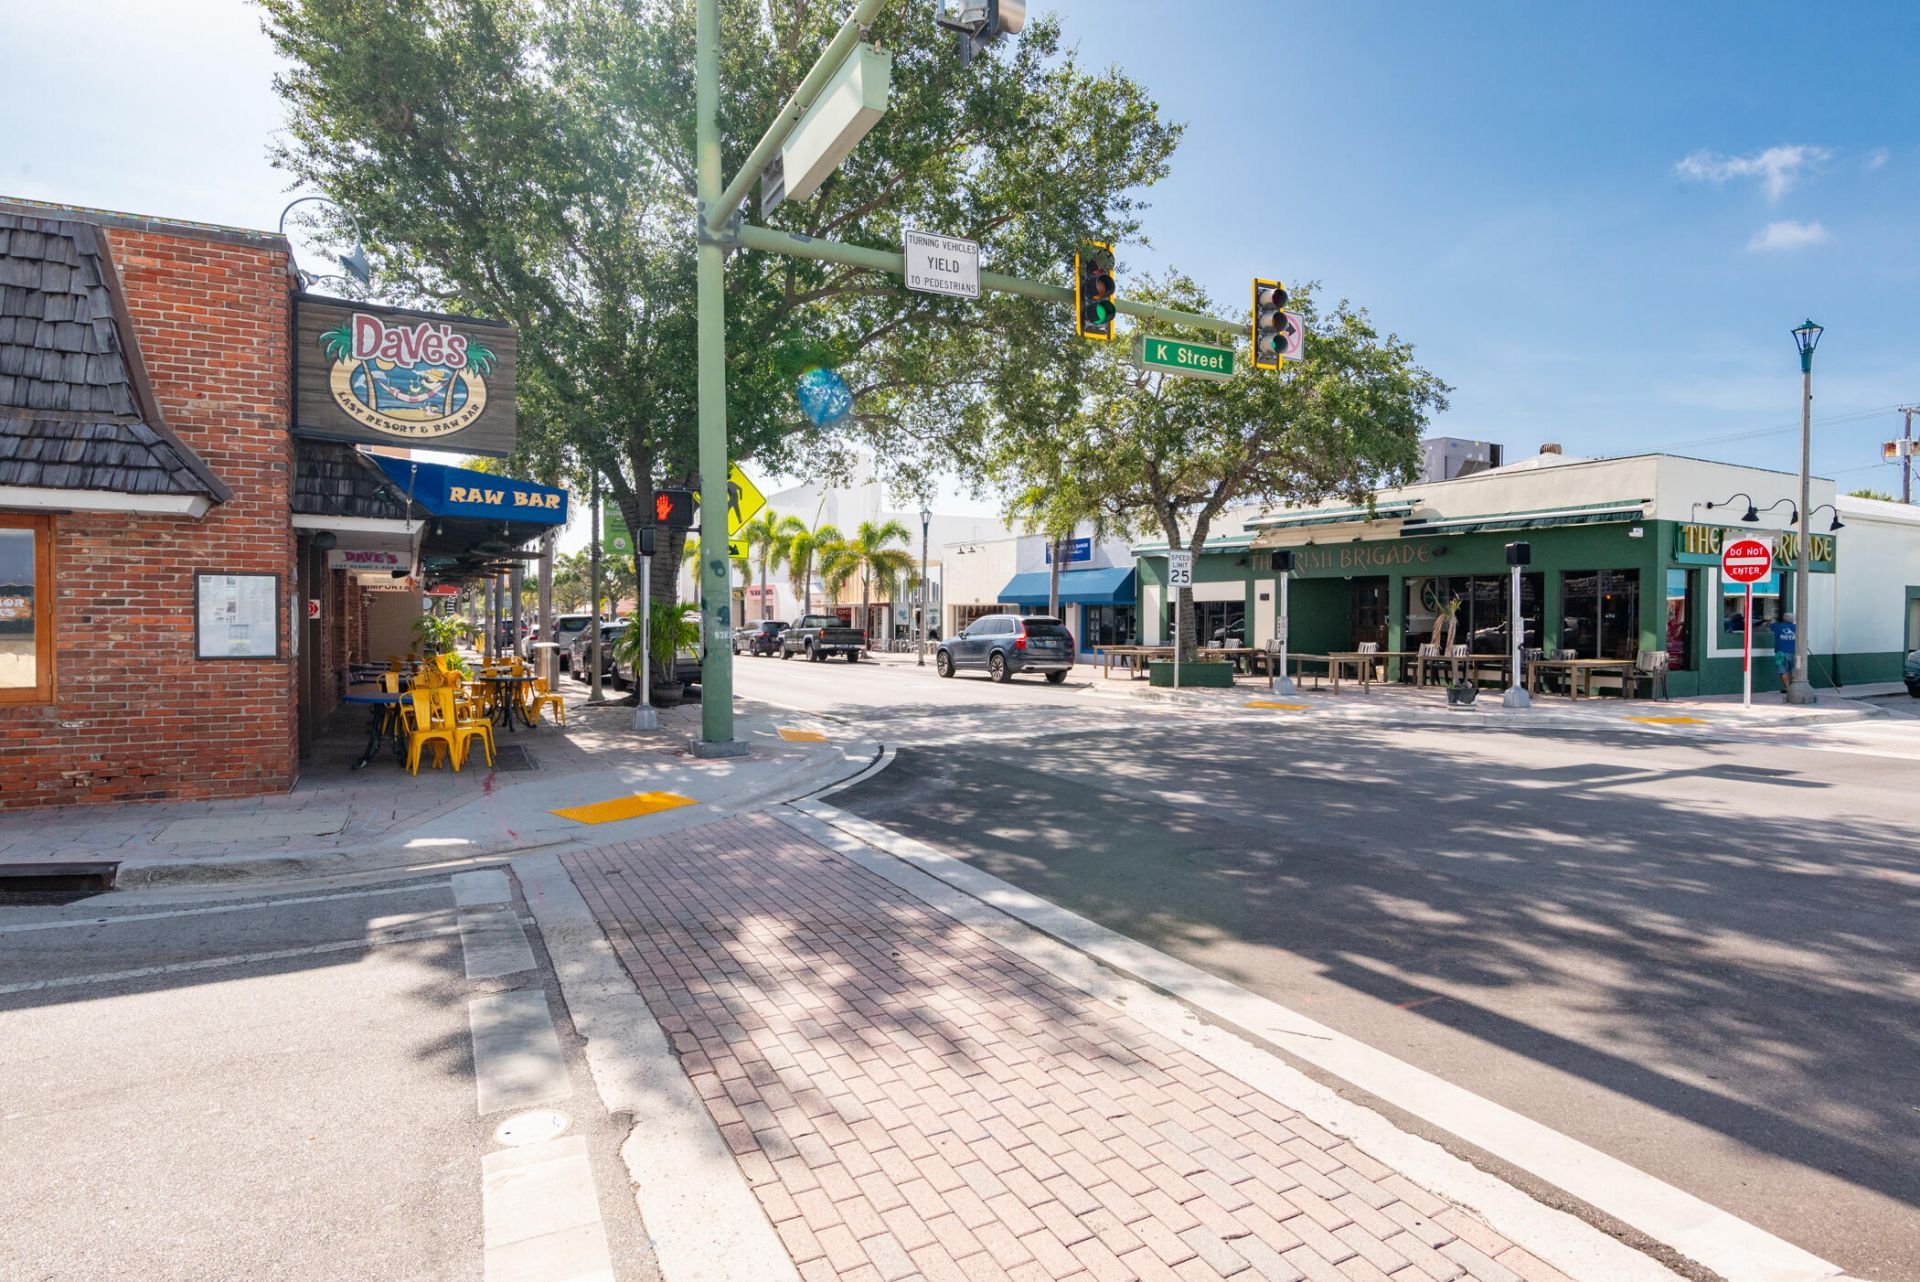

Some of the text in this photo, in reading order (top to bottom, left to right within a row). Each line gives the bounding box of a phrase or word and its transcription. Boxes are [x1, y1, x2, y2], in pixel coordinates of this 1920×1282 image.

[908, 234, 977, 255] TURNING VEHICLES
[927, 255, 960, 273] YIELD
[911, 274, 977, 294] TO PEDESTRIANS
[1156, 343, 1224, 369] K Street
[337, 391, 481, 434] LAST RESORT & RAW BAR
[449, 486, 561, 509] RAW BAR
[1684, 524, 1721, 554] THE
[344, 551, 399, 565] DAVE'S
[1252, 543, 1430, 574] TH RISH BRIGADE
[1729, 546, 1764, 556] DO NOT
[1171, 569, 1190, 583] 25
[1732, 567, 1760, 575] ENTER
